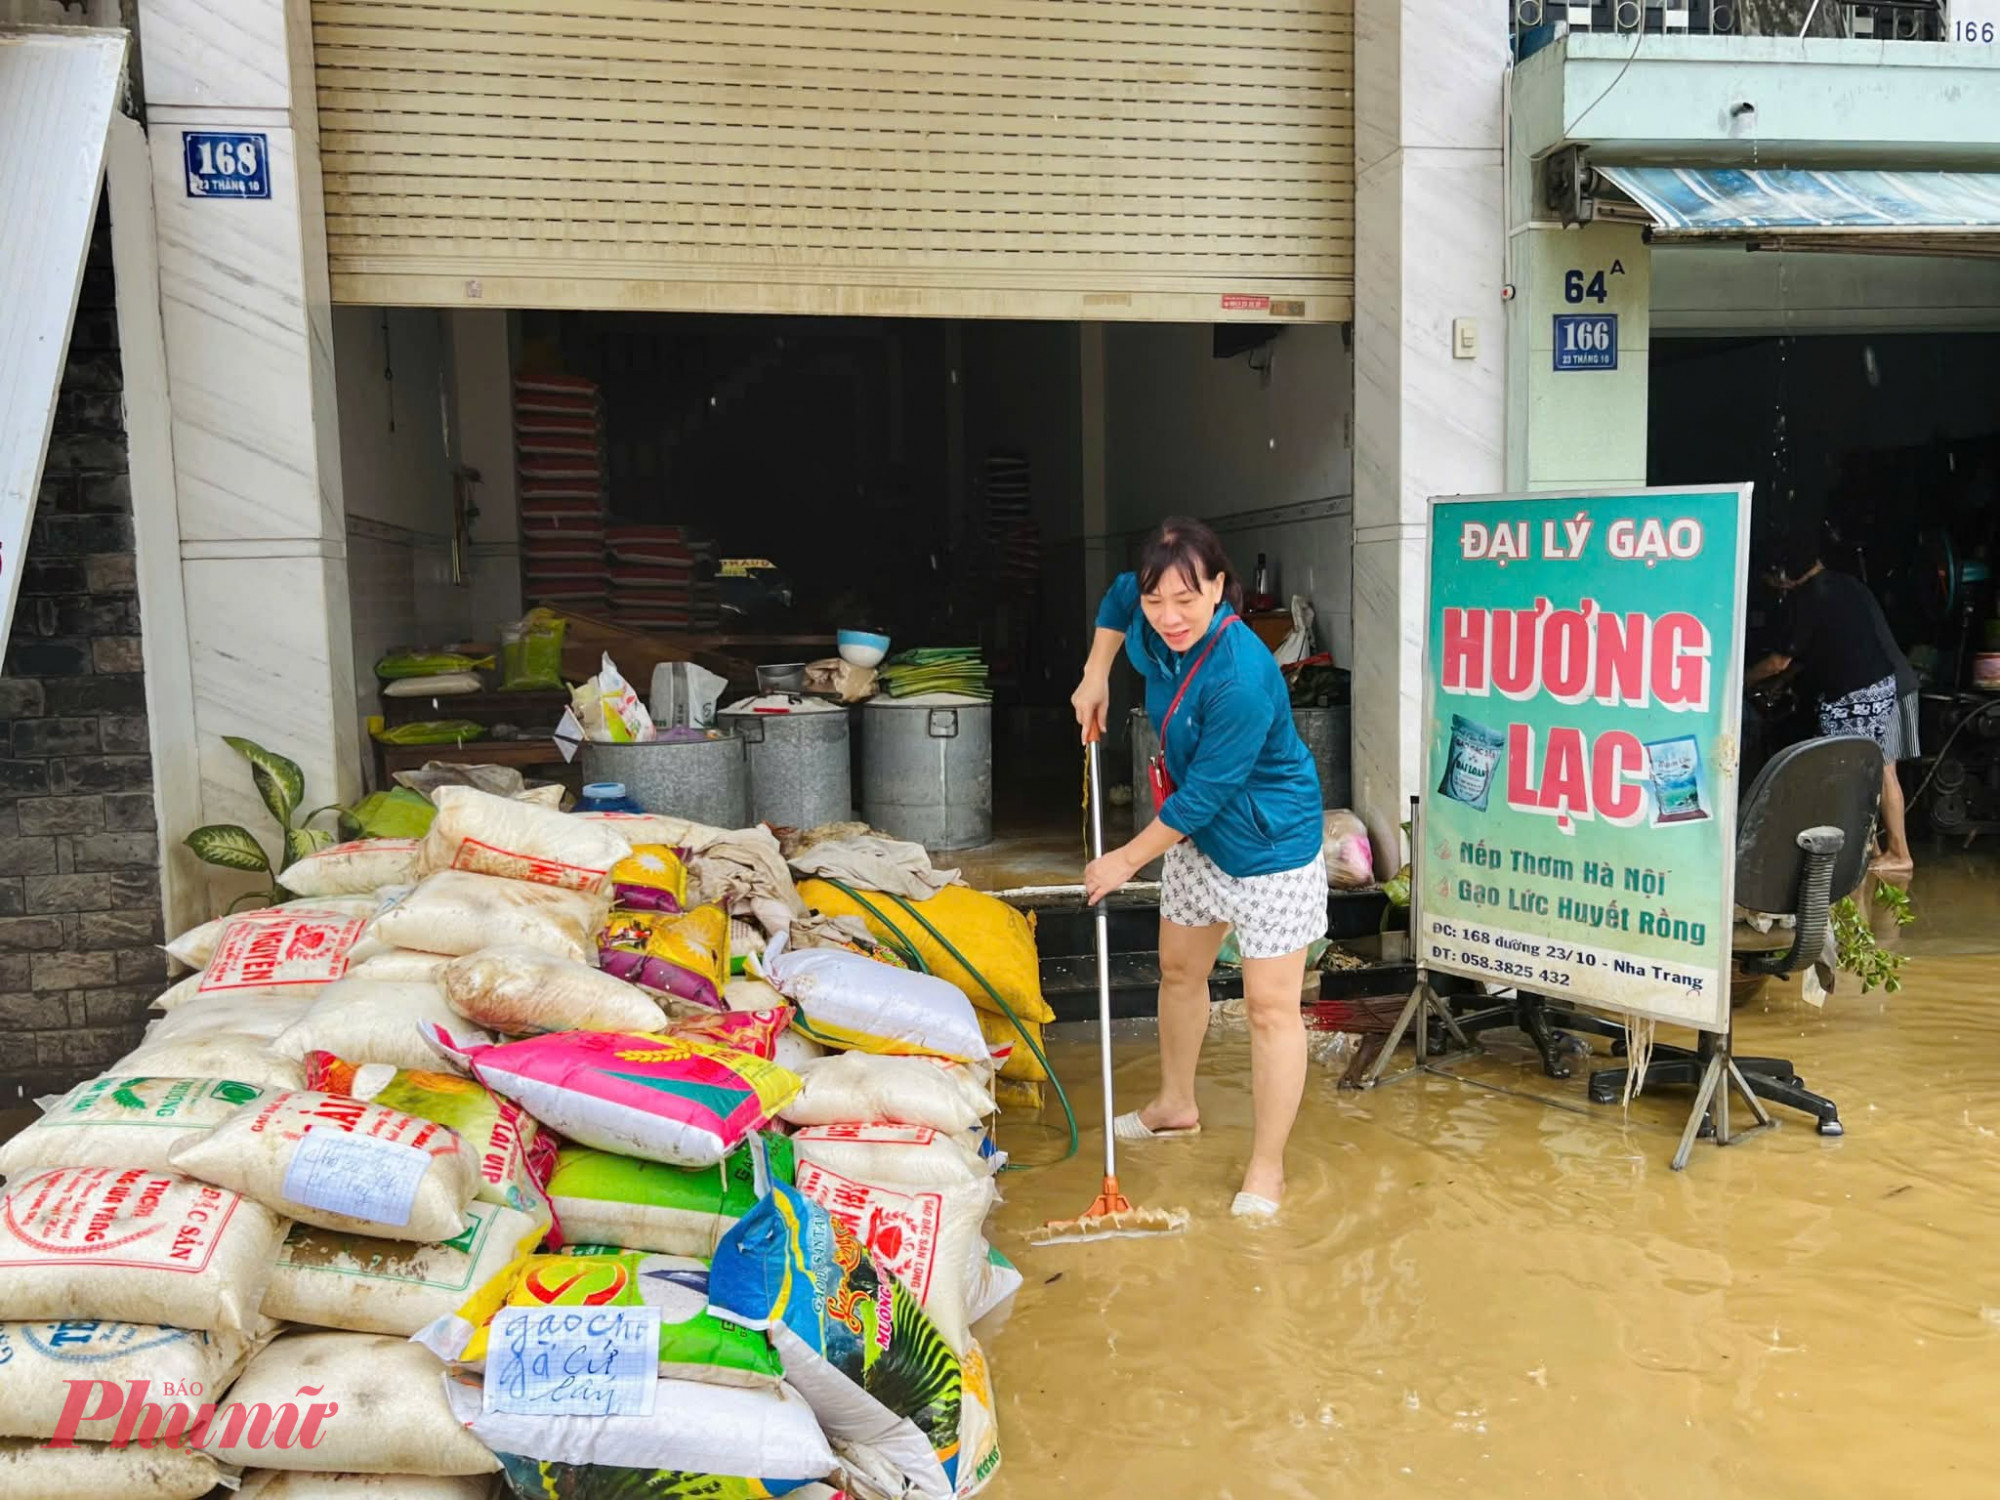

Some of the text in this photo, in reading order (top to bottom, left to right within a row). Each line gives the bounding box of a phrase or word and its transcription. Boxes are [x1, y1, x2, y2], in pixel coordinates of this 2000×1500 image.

[1956, 20, 1994, 43] 166
[197, 141, 257, 176] 168
[248, 180, 260, 192] 10
[1563, 321, 1609, 351] 166
[1562, 352, 1610, 364] 23 THÁNG 10
[1461, 511, 1702, 568] ĐẠI LÝ GẠO
[1442, 597, 1711, 712] HƯƠNG
[1507, 722, 1648, 834] LẠC
[1460, 839, 1665, 899] Nếp Thơm Hà Nội
[1458, 879, 1500, 908] Gạo
[1558, 899, 1629, 932] Huyết
[1639, 907, 1706, 946] Rồng
[1432, 922, 1456, 938] ĐC:
[1462, 929, 1490, 945] 168
[1614, 960, 1646, 977] Nha
[1651, 966, 1703, 989] Trang
[1432, 946, 1570, 986] ĐT: 058.3825 432
[169, 1225, 204, 1261] SẢN
[911, 1262, 924, 1288] LONG
